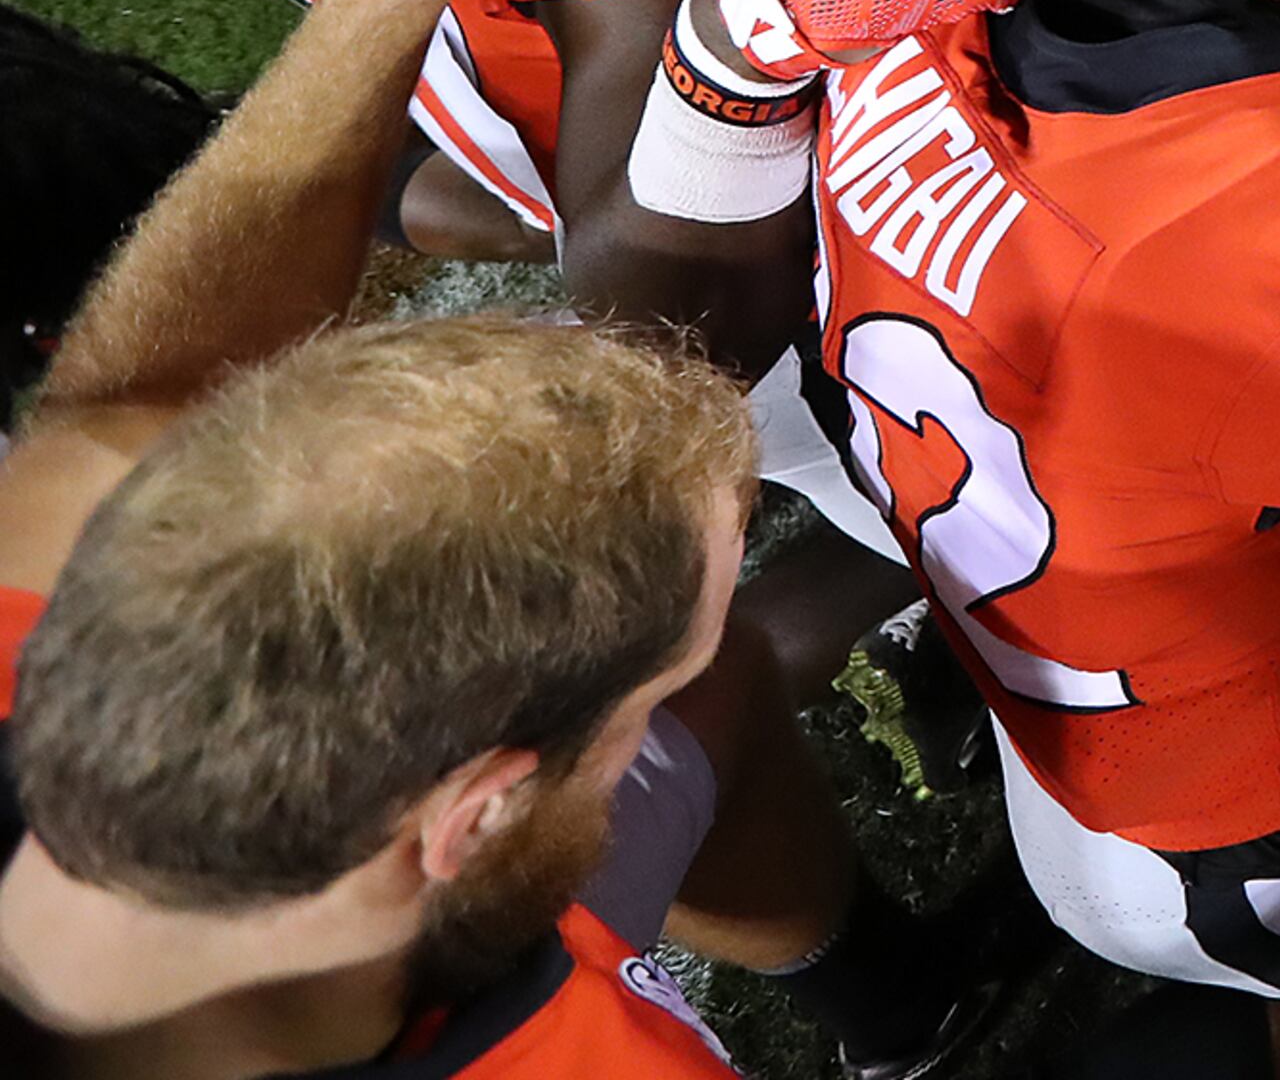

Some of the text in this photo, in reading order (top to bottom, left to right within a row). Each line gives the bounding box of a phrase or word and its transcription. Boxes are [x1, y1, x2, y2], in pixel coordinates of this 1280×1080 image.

[663, 28, 802, 122] EORGIA
[826, 34, 1028, 318] HIGBU
[840, 312, 1143, 713] 2
